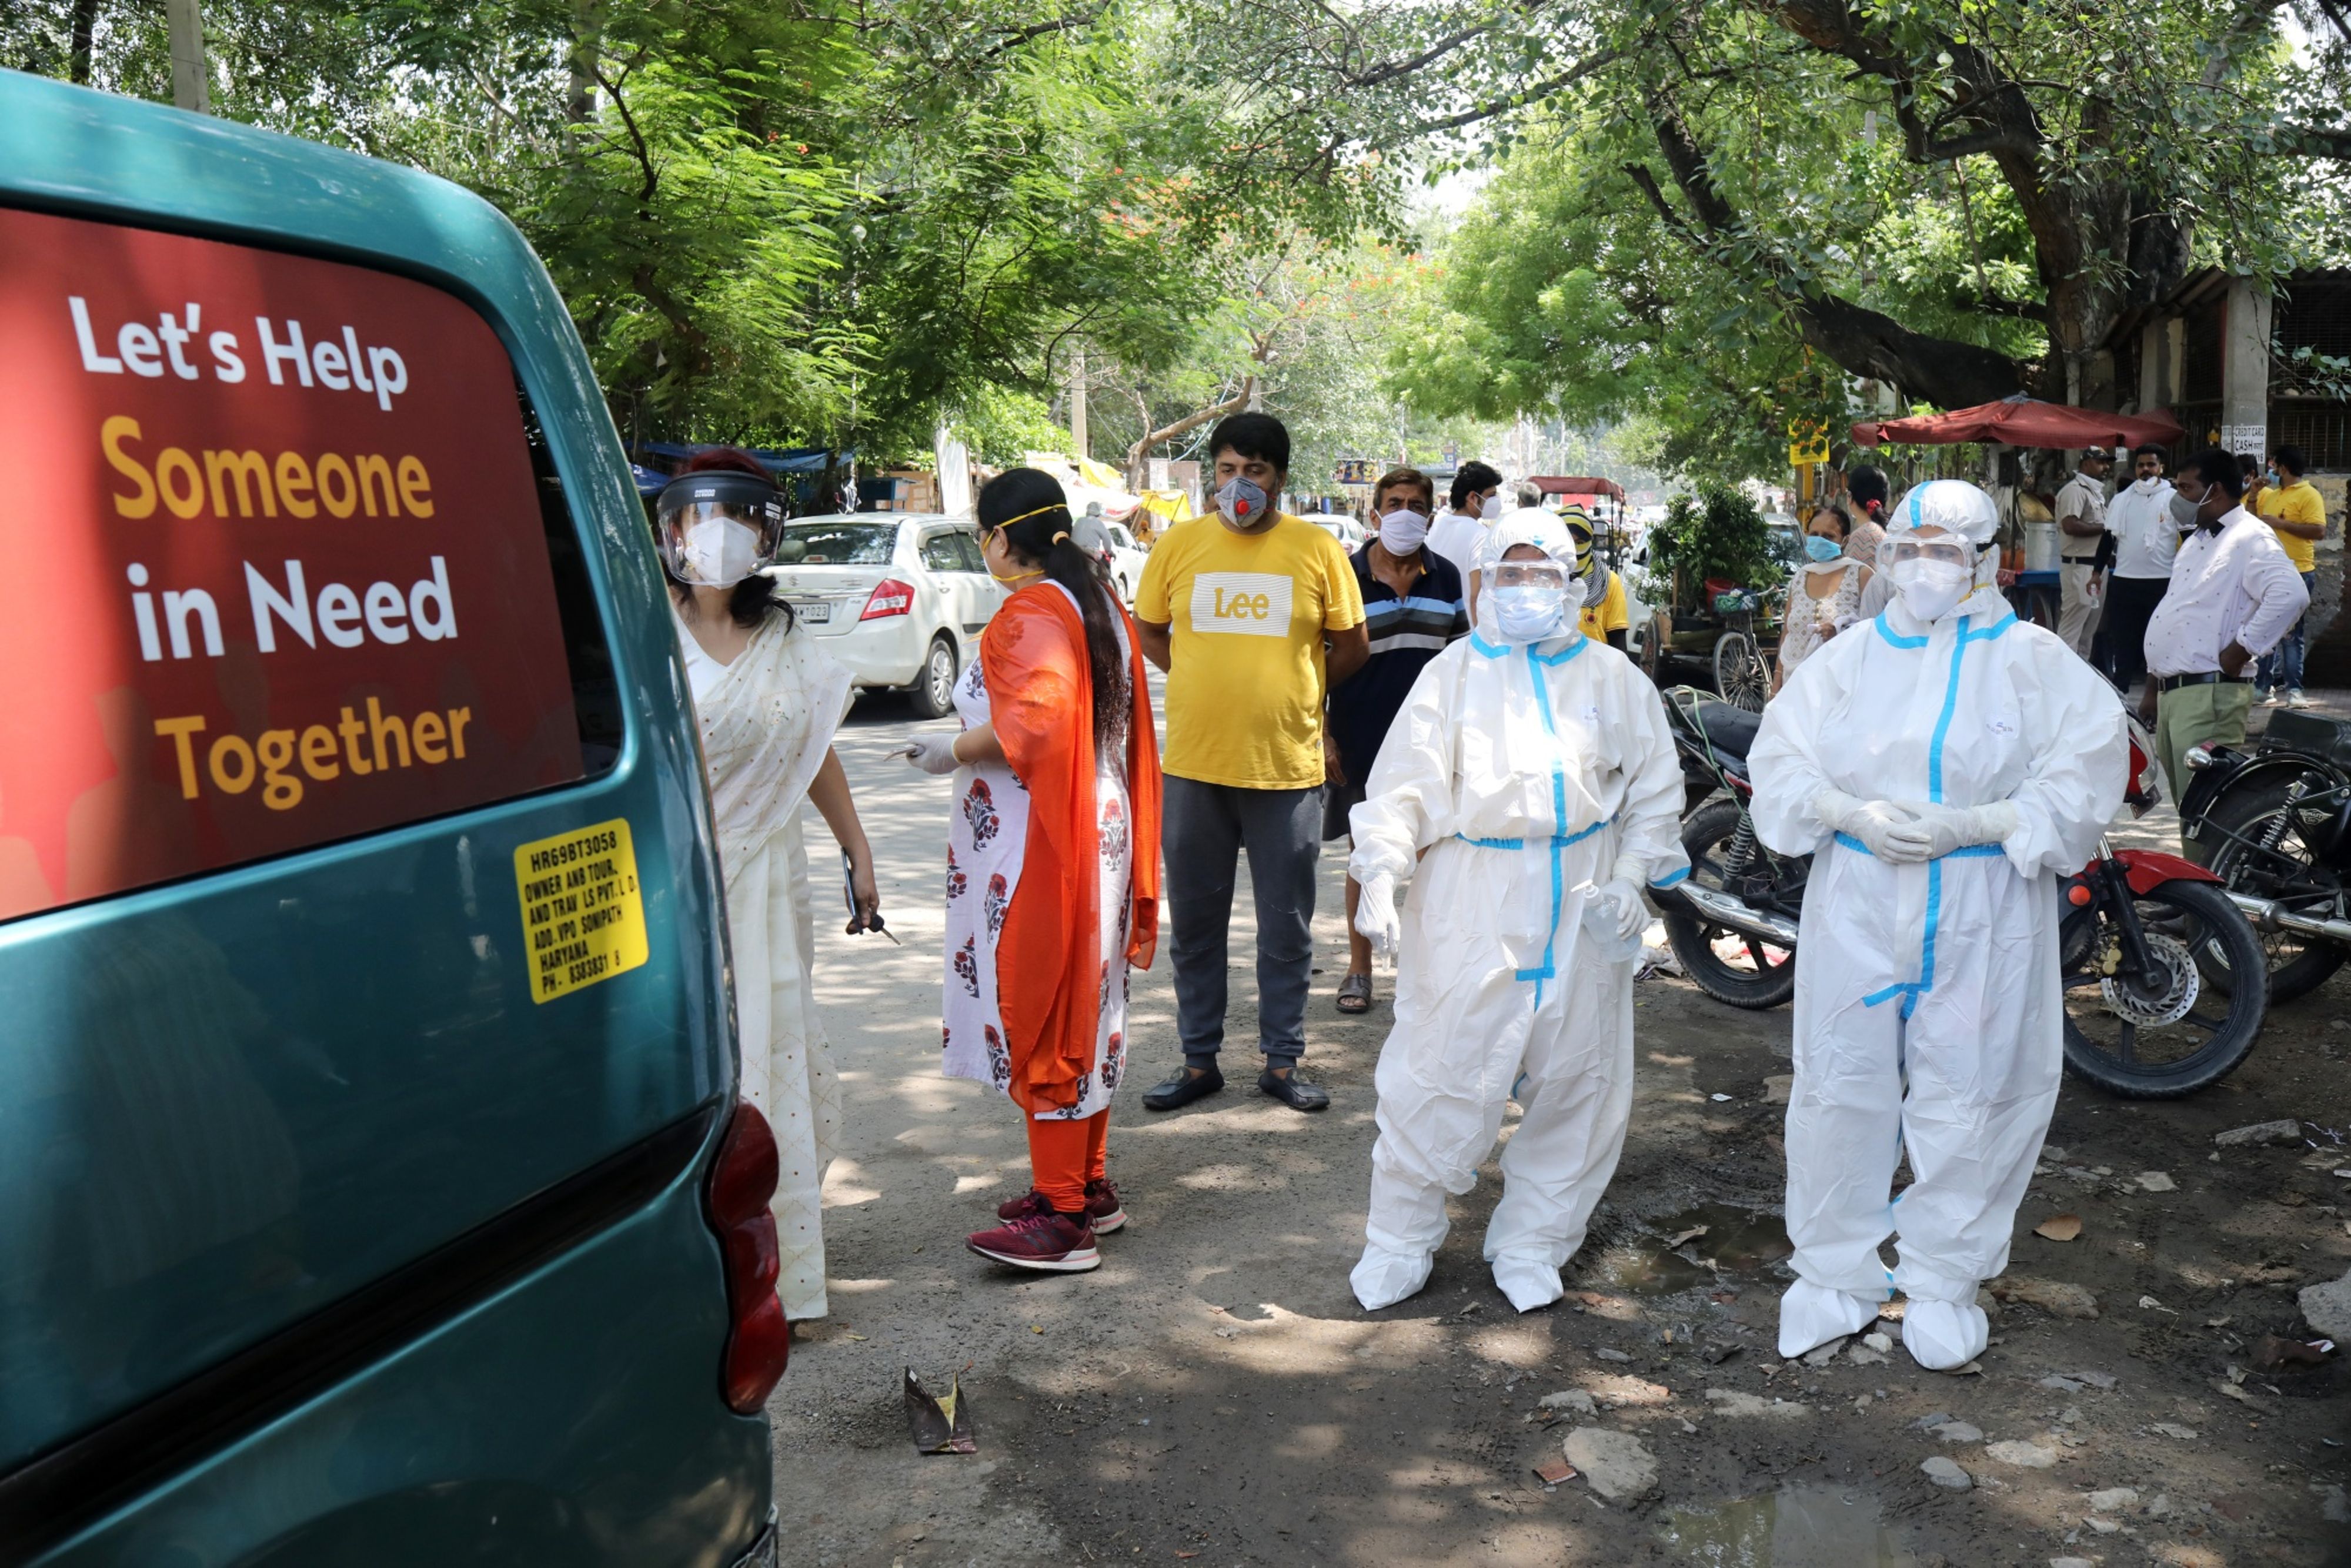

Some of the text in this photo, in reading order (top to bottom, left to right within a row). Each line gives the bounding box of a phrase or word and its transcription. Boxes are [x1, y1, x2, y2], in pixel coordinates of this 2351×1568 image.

[68, 296, 408, 411] Let's Help
[2235, 440, 2253, 451] CASH
[2252, 427, 2264, 436] CARD
[101, 415, 434, 519] Someone
[128, 556, 457, 661] in Need
[1214, 587, 1270, 621] Lee
[155, 698, 470, 810] Together
[530, 831, 617, 872] HR69BT3058
[525, 874, 563, 902] OWNER
[530, 903, 550, 927] AND
[540, 940, 589, 973] HARYANA
